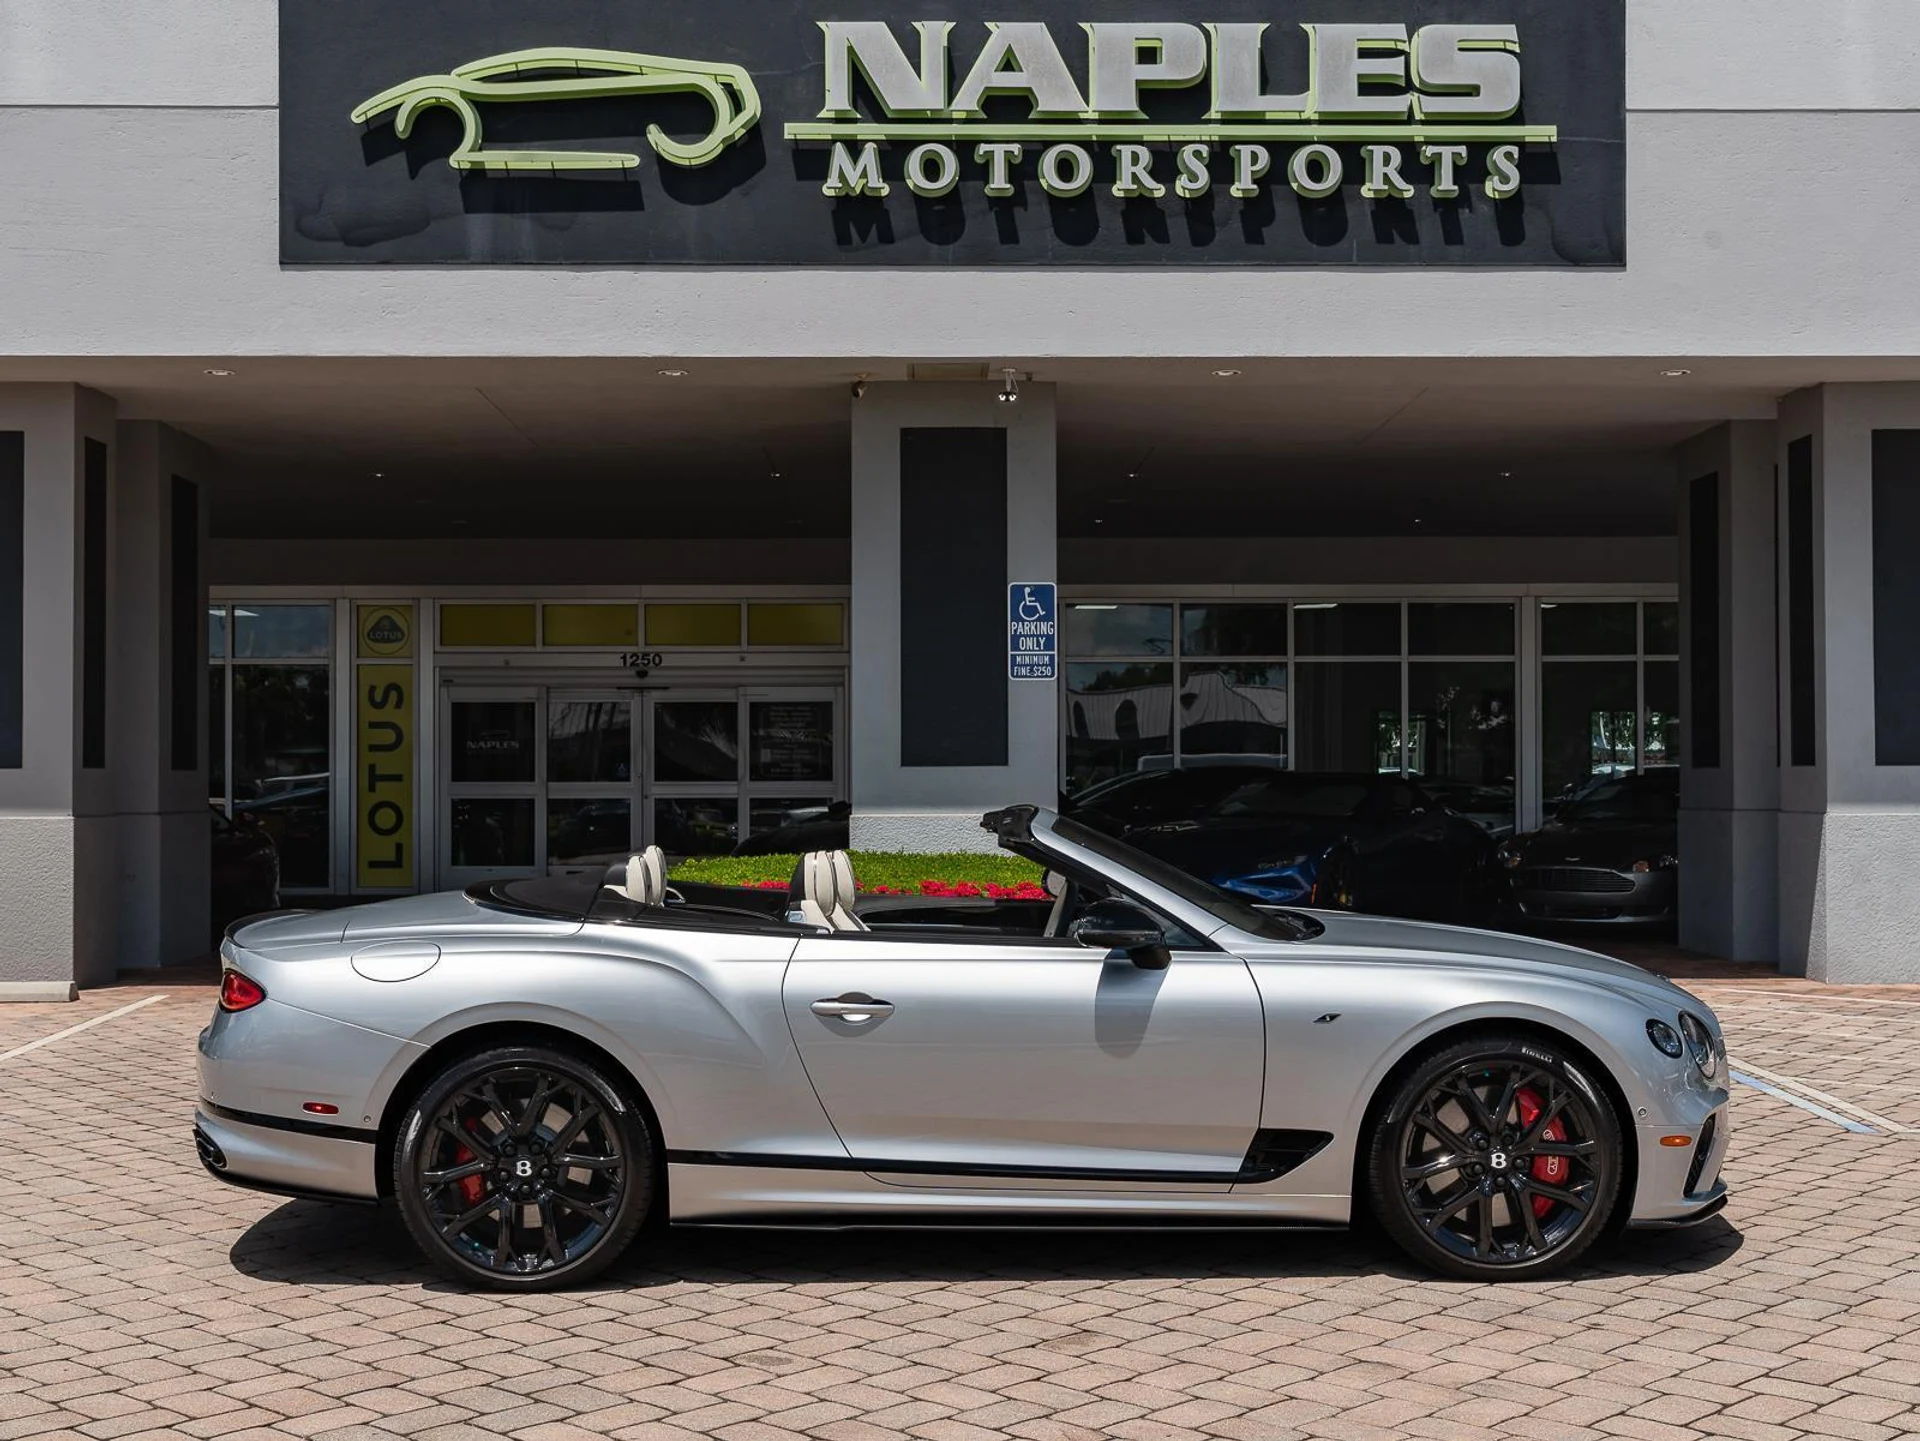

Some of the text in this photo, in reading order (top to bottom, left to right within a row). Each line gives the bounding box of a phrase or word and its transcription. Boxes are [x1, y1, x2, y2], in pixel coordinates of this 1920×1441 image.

[815, 21, 1520, 120] NAPLES
[822, 142, 1519, 198] MOTORSPORTS
[1011, 621, 1054, 635] PARKING
[369, 630, 402, 641] LOTUS
[1019, 637, 1046, 650] ONLY
[620, 653, 662, 667] 1250
[1016, 655, 1049, 665] MINIMUM
[1013, 665, 1052, 676] FINE $250
[367, 682, 404, 869] LOTUS
[1491, 1152, 1507, 1168] B
[516, 1160, 532, 1176] B
